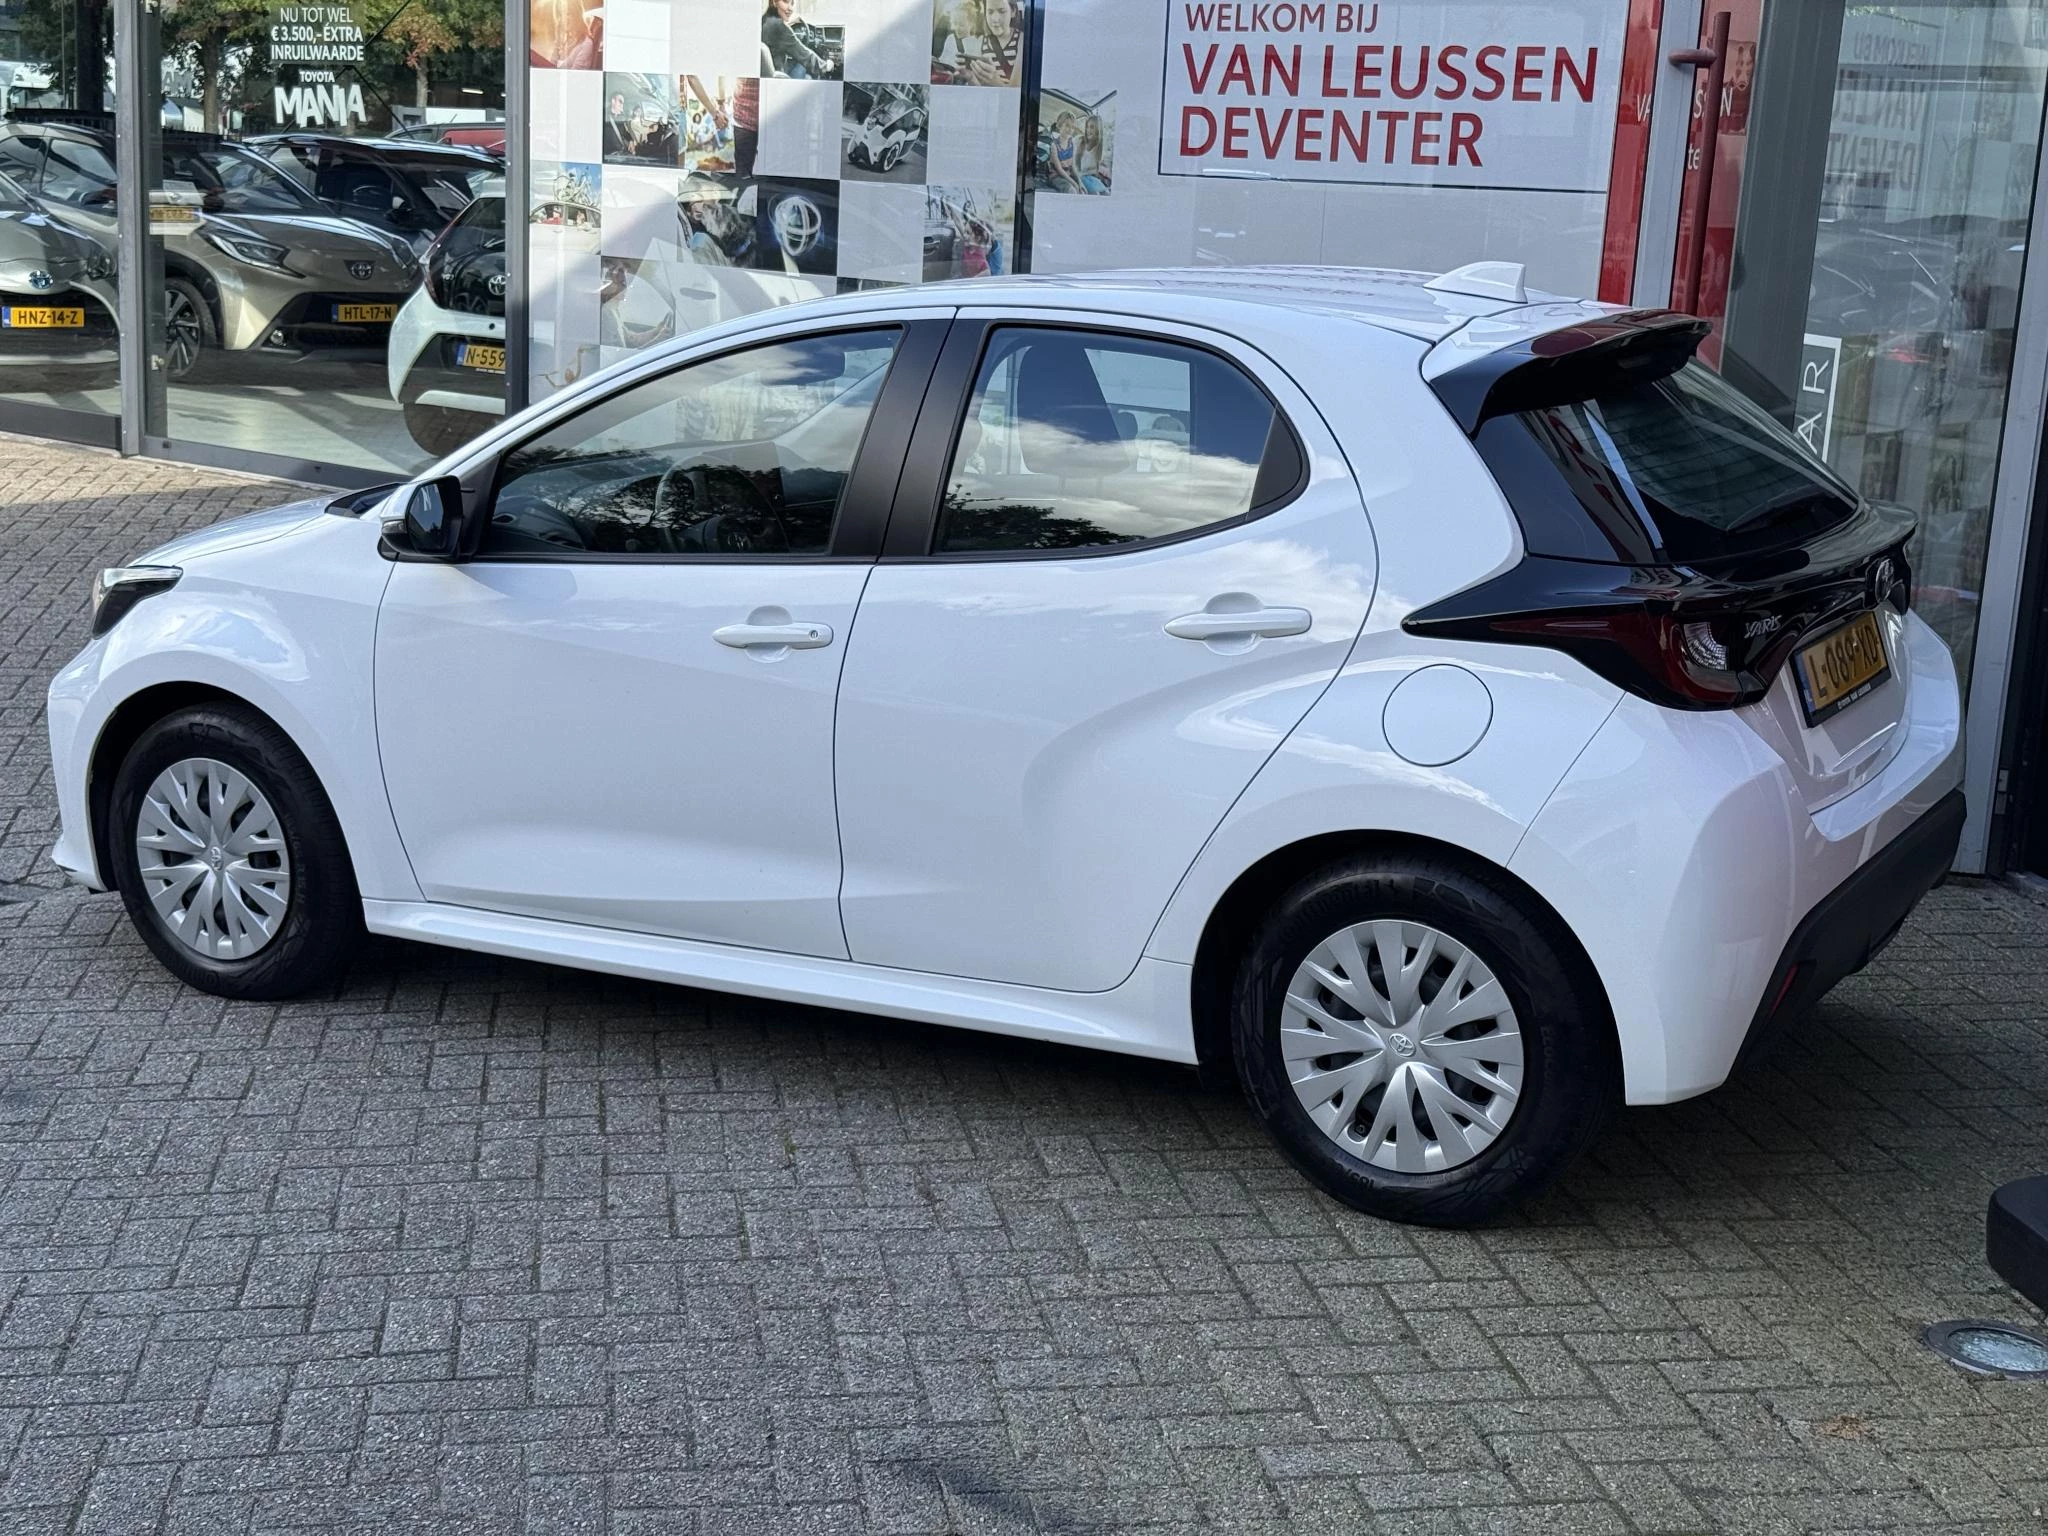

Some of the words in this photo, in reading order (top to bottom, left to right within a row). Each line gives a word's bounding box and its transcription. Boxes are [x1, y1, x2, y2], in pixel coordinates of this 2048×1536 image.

[280, 7, 299, 22] NU
[301, 7, 325, 23] TOT
[327, 7, 354, 23] WEL
[1185, 3, 1326, 33] WELKOM
[1335, 3, 1379, 33] BIJ
[271, 45, 364, 61] INRUILWAARDE
[299, 71, 335, 82] TOYOTA
[1182, 43, 1302, 97] VAN
[1321, 44, 1599, 103] LEUSSEN
[274, 84, 367, 128] MANIA
[1179, 105, 1484, 167] DEVENTER
[18, 310, 79, 325] HNZ-14-Z
[344, 306, 392, 320] HTL-17-N
[1744, 615, 1783, 639] YARIS
[1809, 624, 1880, 698] L-089-XD
